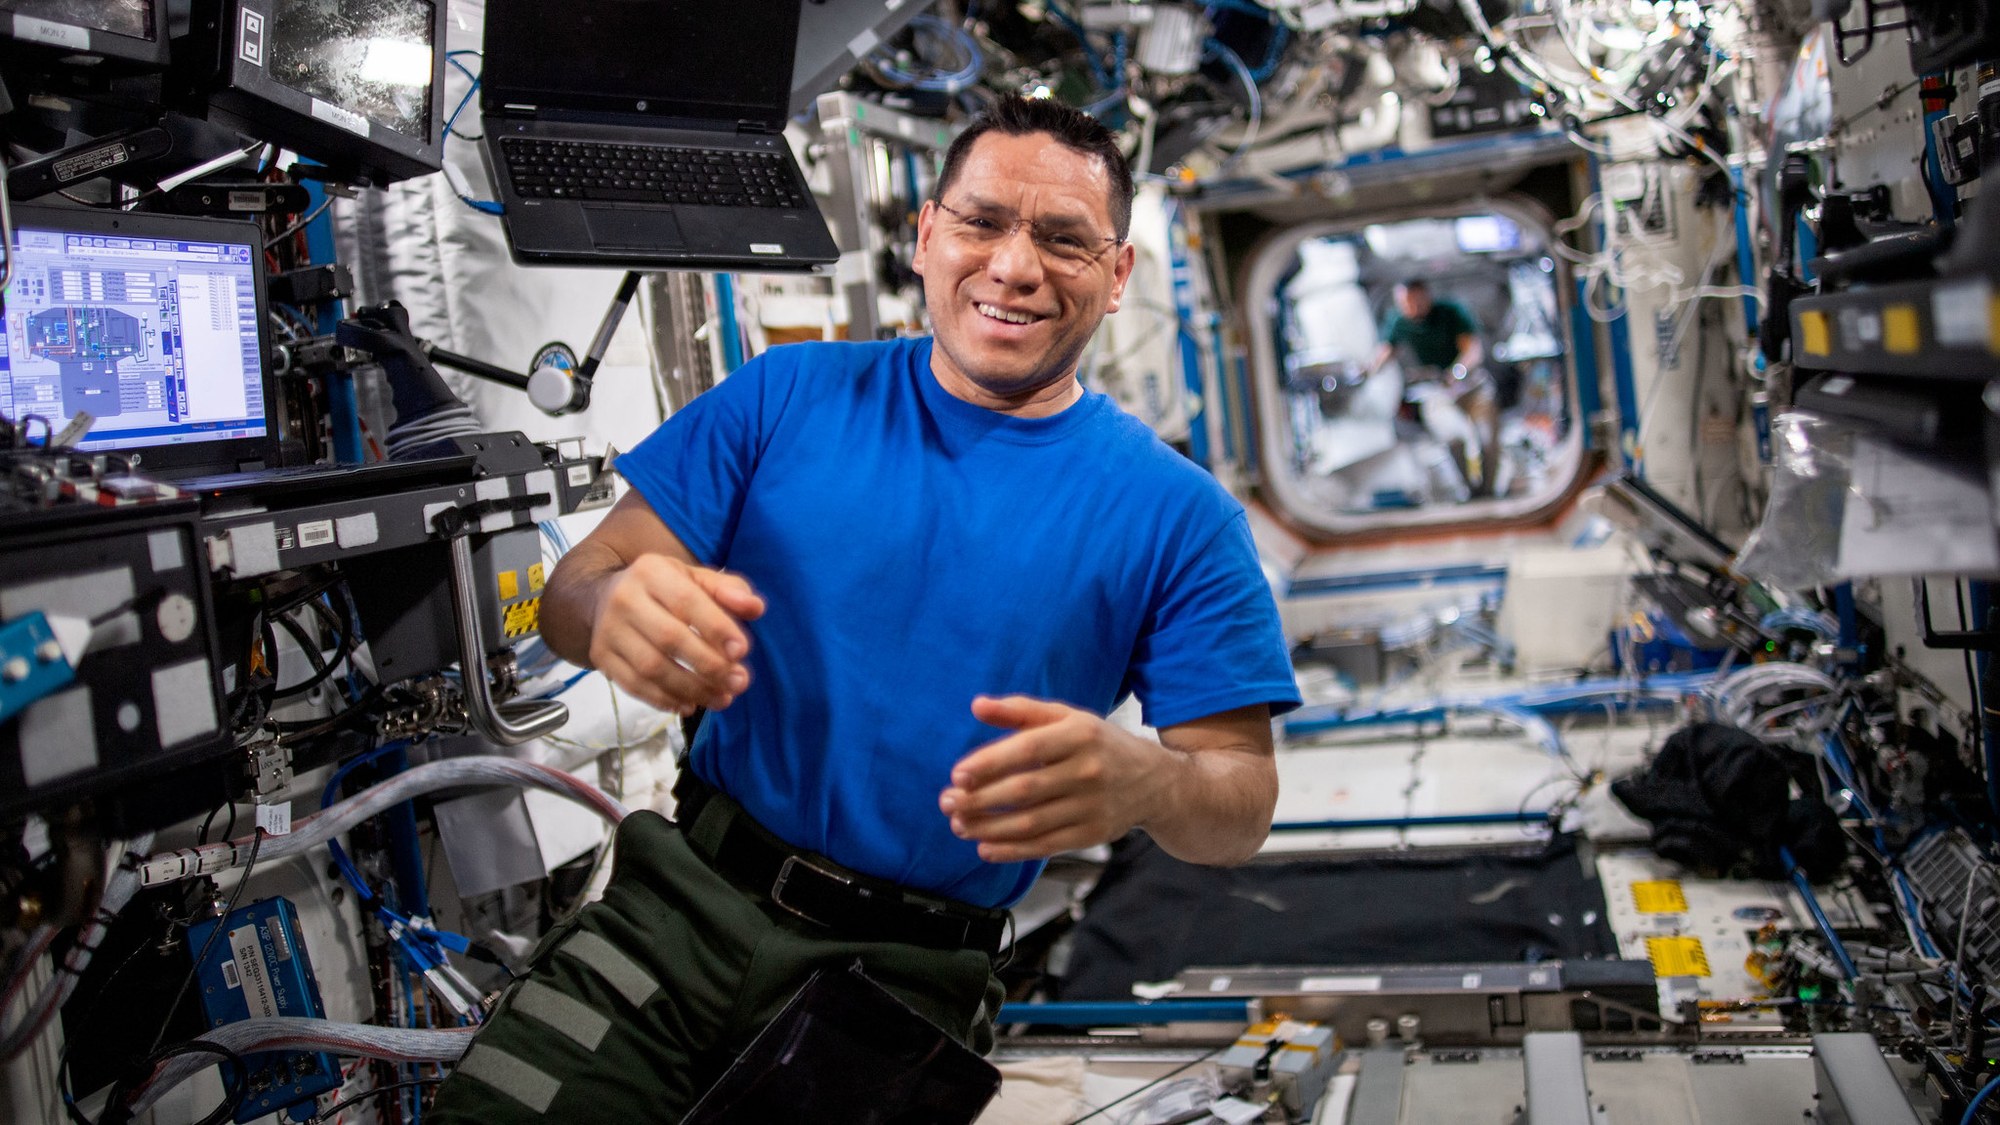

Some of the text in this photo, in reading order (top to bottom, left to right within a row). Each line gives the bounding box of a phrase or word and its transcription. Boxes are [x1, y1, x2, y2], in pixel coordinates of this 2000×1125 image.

[60, 31, 66, 39] 2
[131, 453, 142, 465] hp
[261, 761, 273, 770] LOCK
[247, 945, 255, 958] P/N
[239, 948, 252, 977] S/N 1342
[264, 943, 277, 967] 120VDC
[272, 967, 281, 986] Power
[277, 988, 288, 1009] Supply
